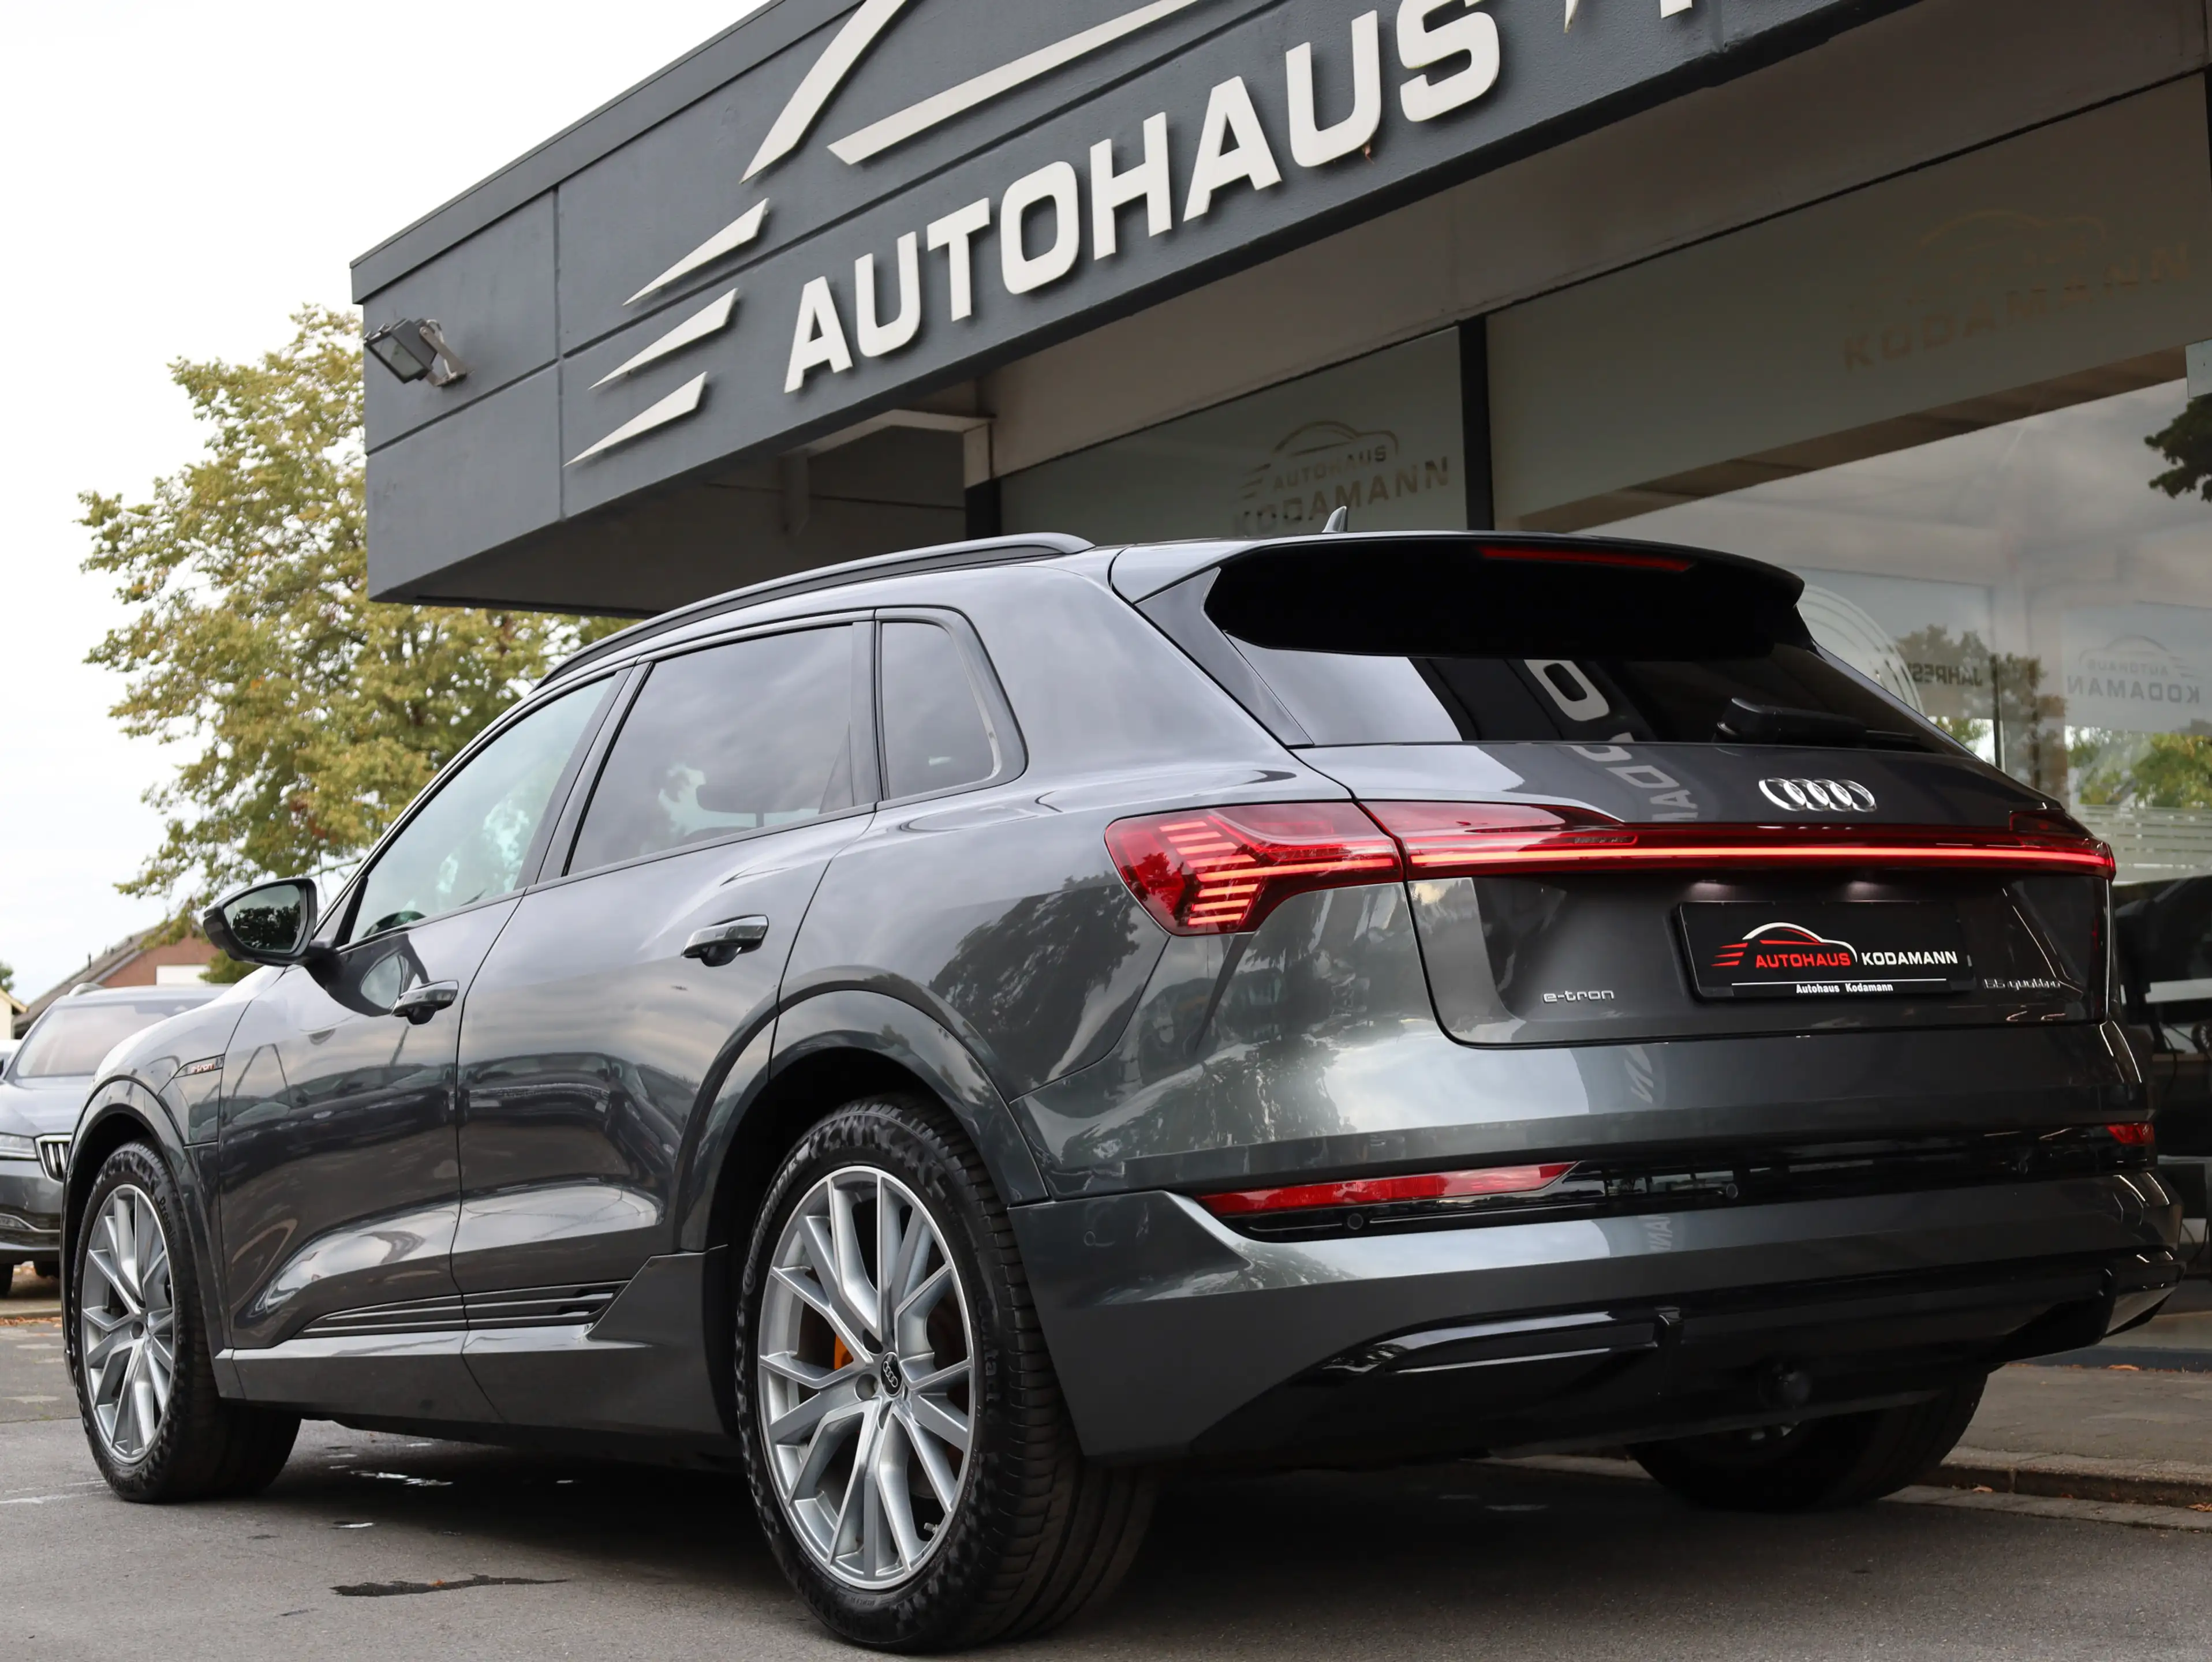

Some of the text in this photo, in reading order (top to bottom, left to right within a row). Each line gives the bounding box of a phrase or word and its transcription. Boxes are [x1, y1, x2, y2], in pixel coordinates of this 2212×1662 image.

[784, 0, 1501, 394] AUTOHAUS
[1843, 241, 2191, 372] KODAMANN
[1273, 445, 1387, 491] AUTOHAUS
[1755, 951, 1959, 968] AUTOHAUS KODAMANN
[1543, 990, 1615, 1003] e-tron
[1796, 982, 1894, 994] Autohaus Kodamann
